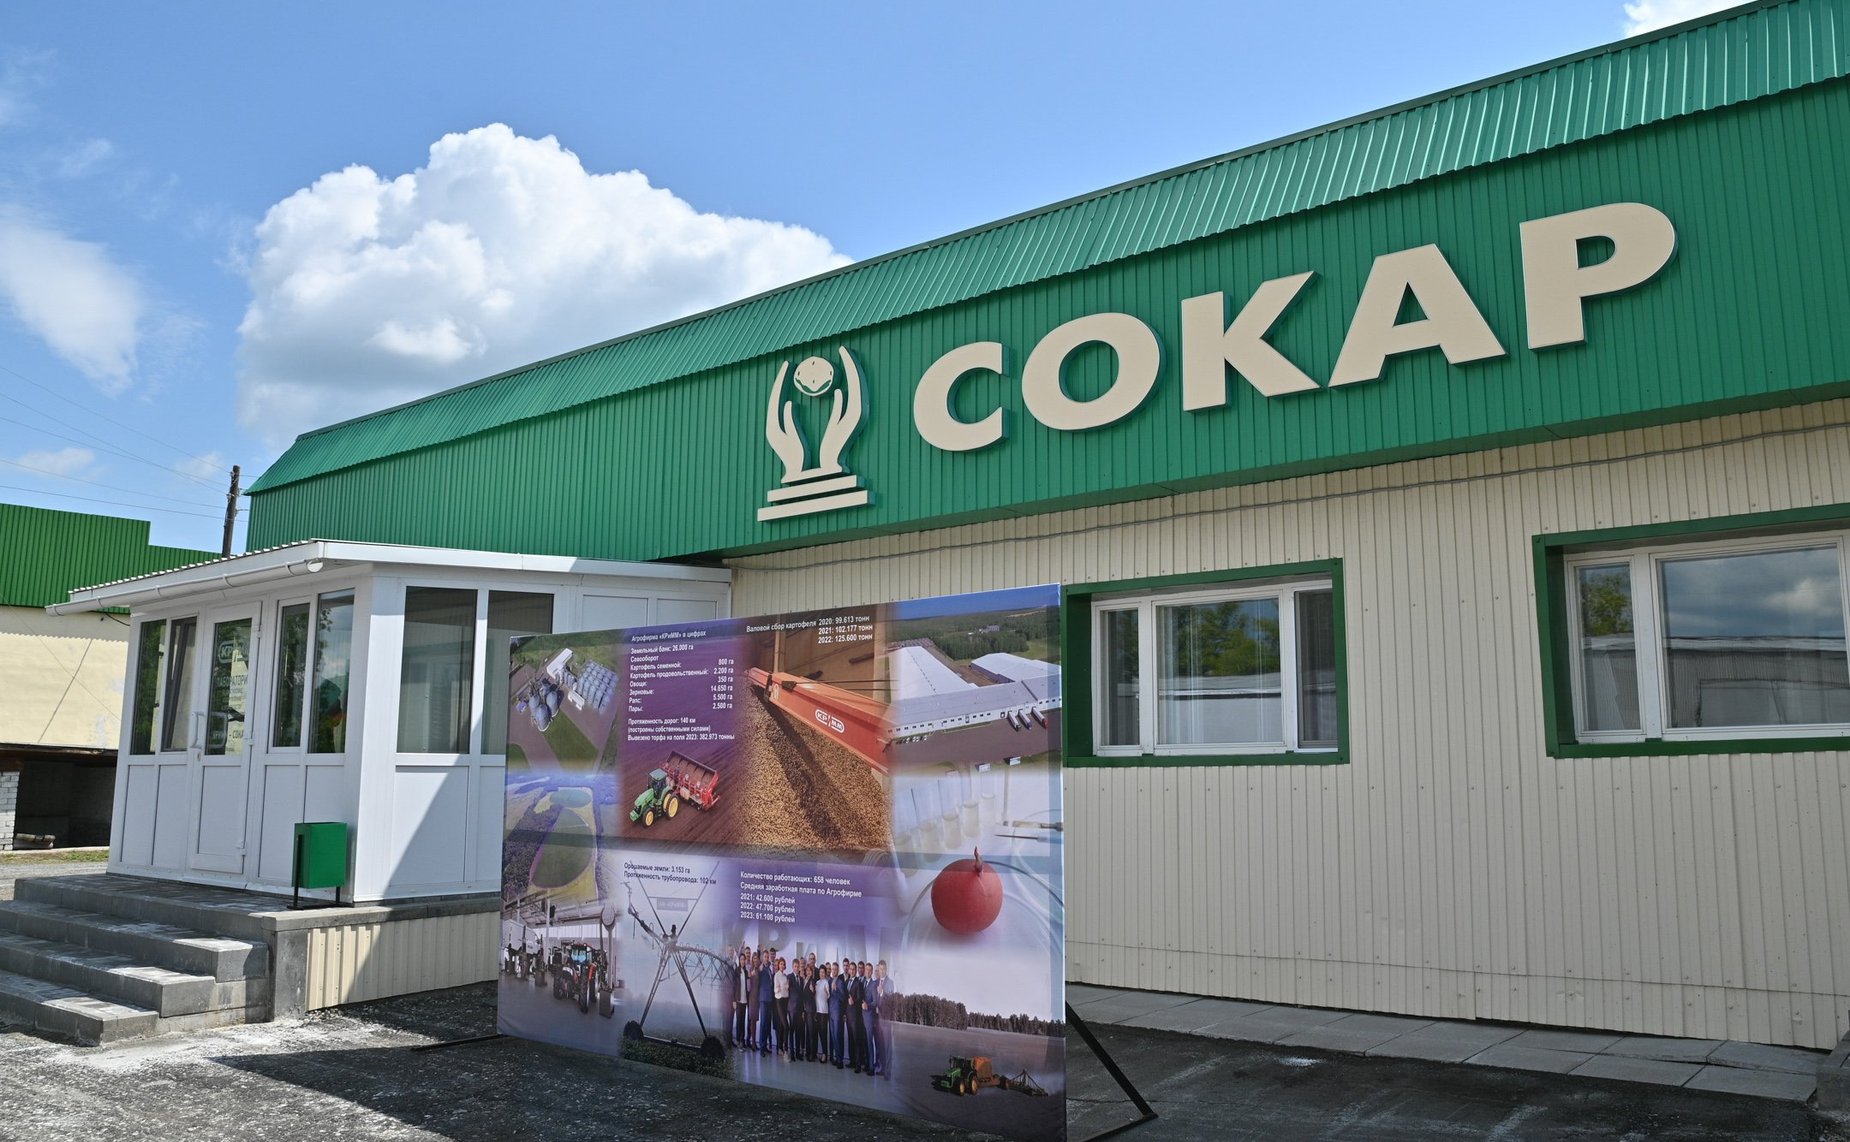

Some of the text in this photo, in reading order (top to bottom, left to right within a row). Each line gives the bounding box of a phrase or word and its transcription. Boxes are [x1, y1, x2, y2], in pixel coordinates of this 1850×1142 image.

[914, 202, 1677, 452] СОКАР
[746, 624, 770, 632] Валовой
[771, 622, 784, 631] сбор
[786, 620, 816, 629] картофеля
[818, 618, 834, 626] 2020:
[835, 616, 854, 624] 99.613
[818, 627, 834, 635] 2021:
[836, 624, 857, 633] 102.177
[818, 636, 833, 644] 2022:
[835, 634, 857, 642] 125.600
[631, 646, 658, 654] Земельный
[662, 875, 698, 884] трубопровода:
[740, 871, 773, 880] Количество
[774, 874, 812, 883] работающих:
[814, 875, 824, 884] 658
[740, 882, 764, 890] Средняя
[765, 884, 798, 892] заработная
[826, 888, 862, 898] Агрофирме
[774, 896, 796, 904] рублей
[756, 903, 773, 911] 47.700
[774, 906, 796, 914] рублей
[774, 915, 796, 923] рублей
